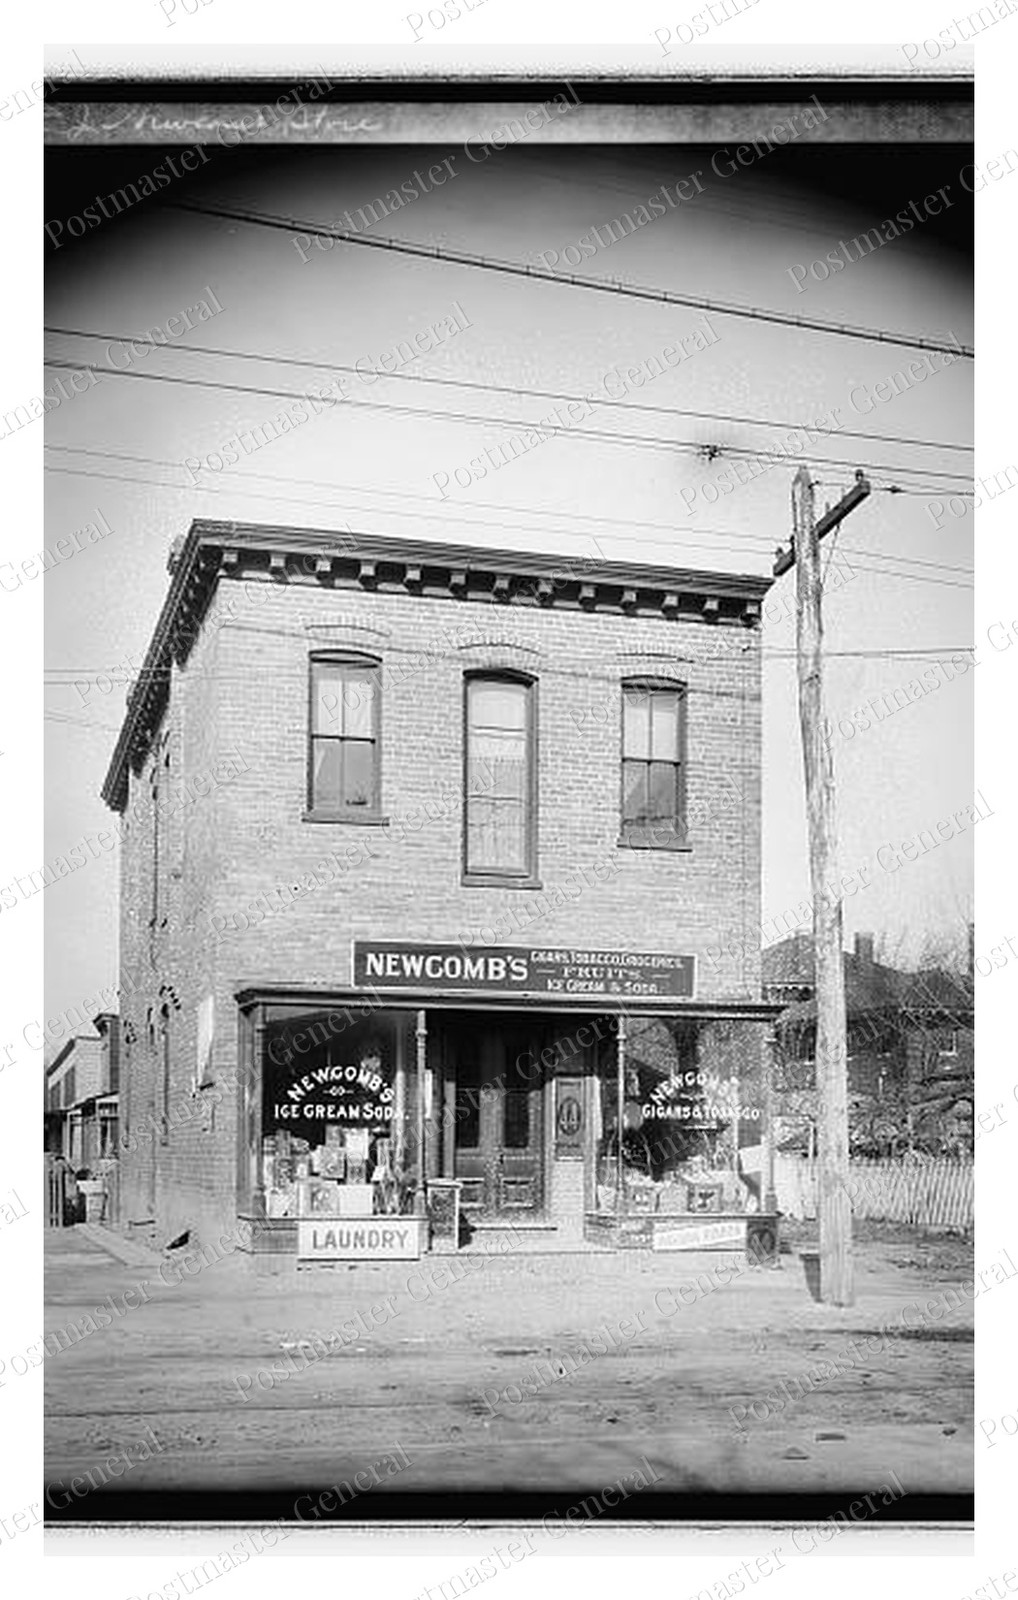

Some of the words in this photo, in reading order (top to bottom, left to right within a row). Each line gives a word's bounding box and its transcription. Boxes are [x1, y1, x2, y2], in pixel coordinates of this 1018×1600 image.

[365, 952, 528, 981] NEWCOMB'S
[286, 1065, 396, 1103] NEWCOMB'S
[274, 1103, 300, 1119] ICE
[312, 1228, 409, 1250] LAUNDRY
